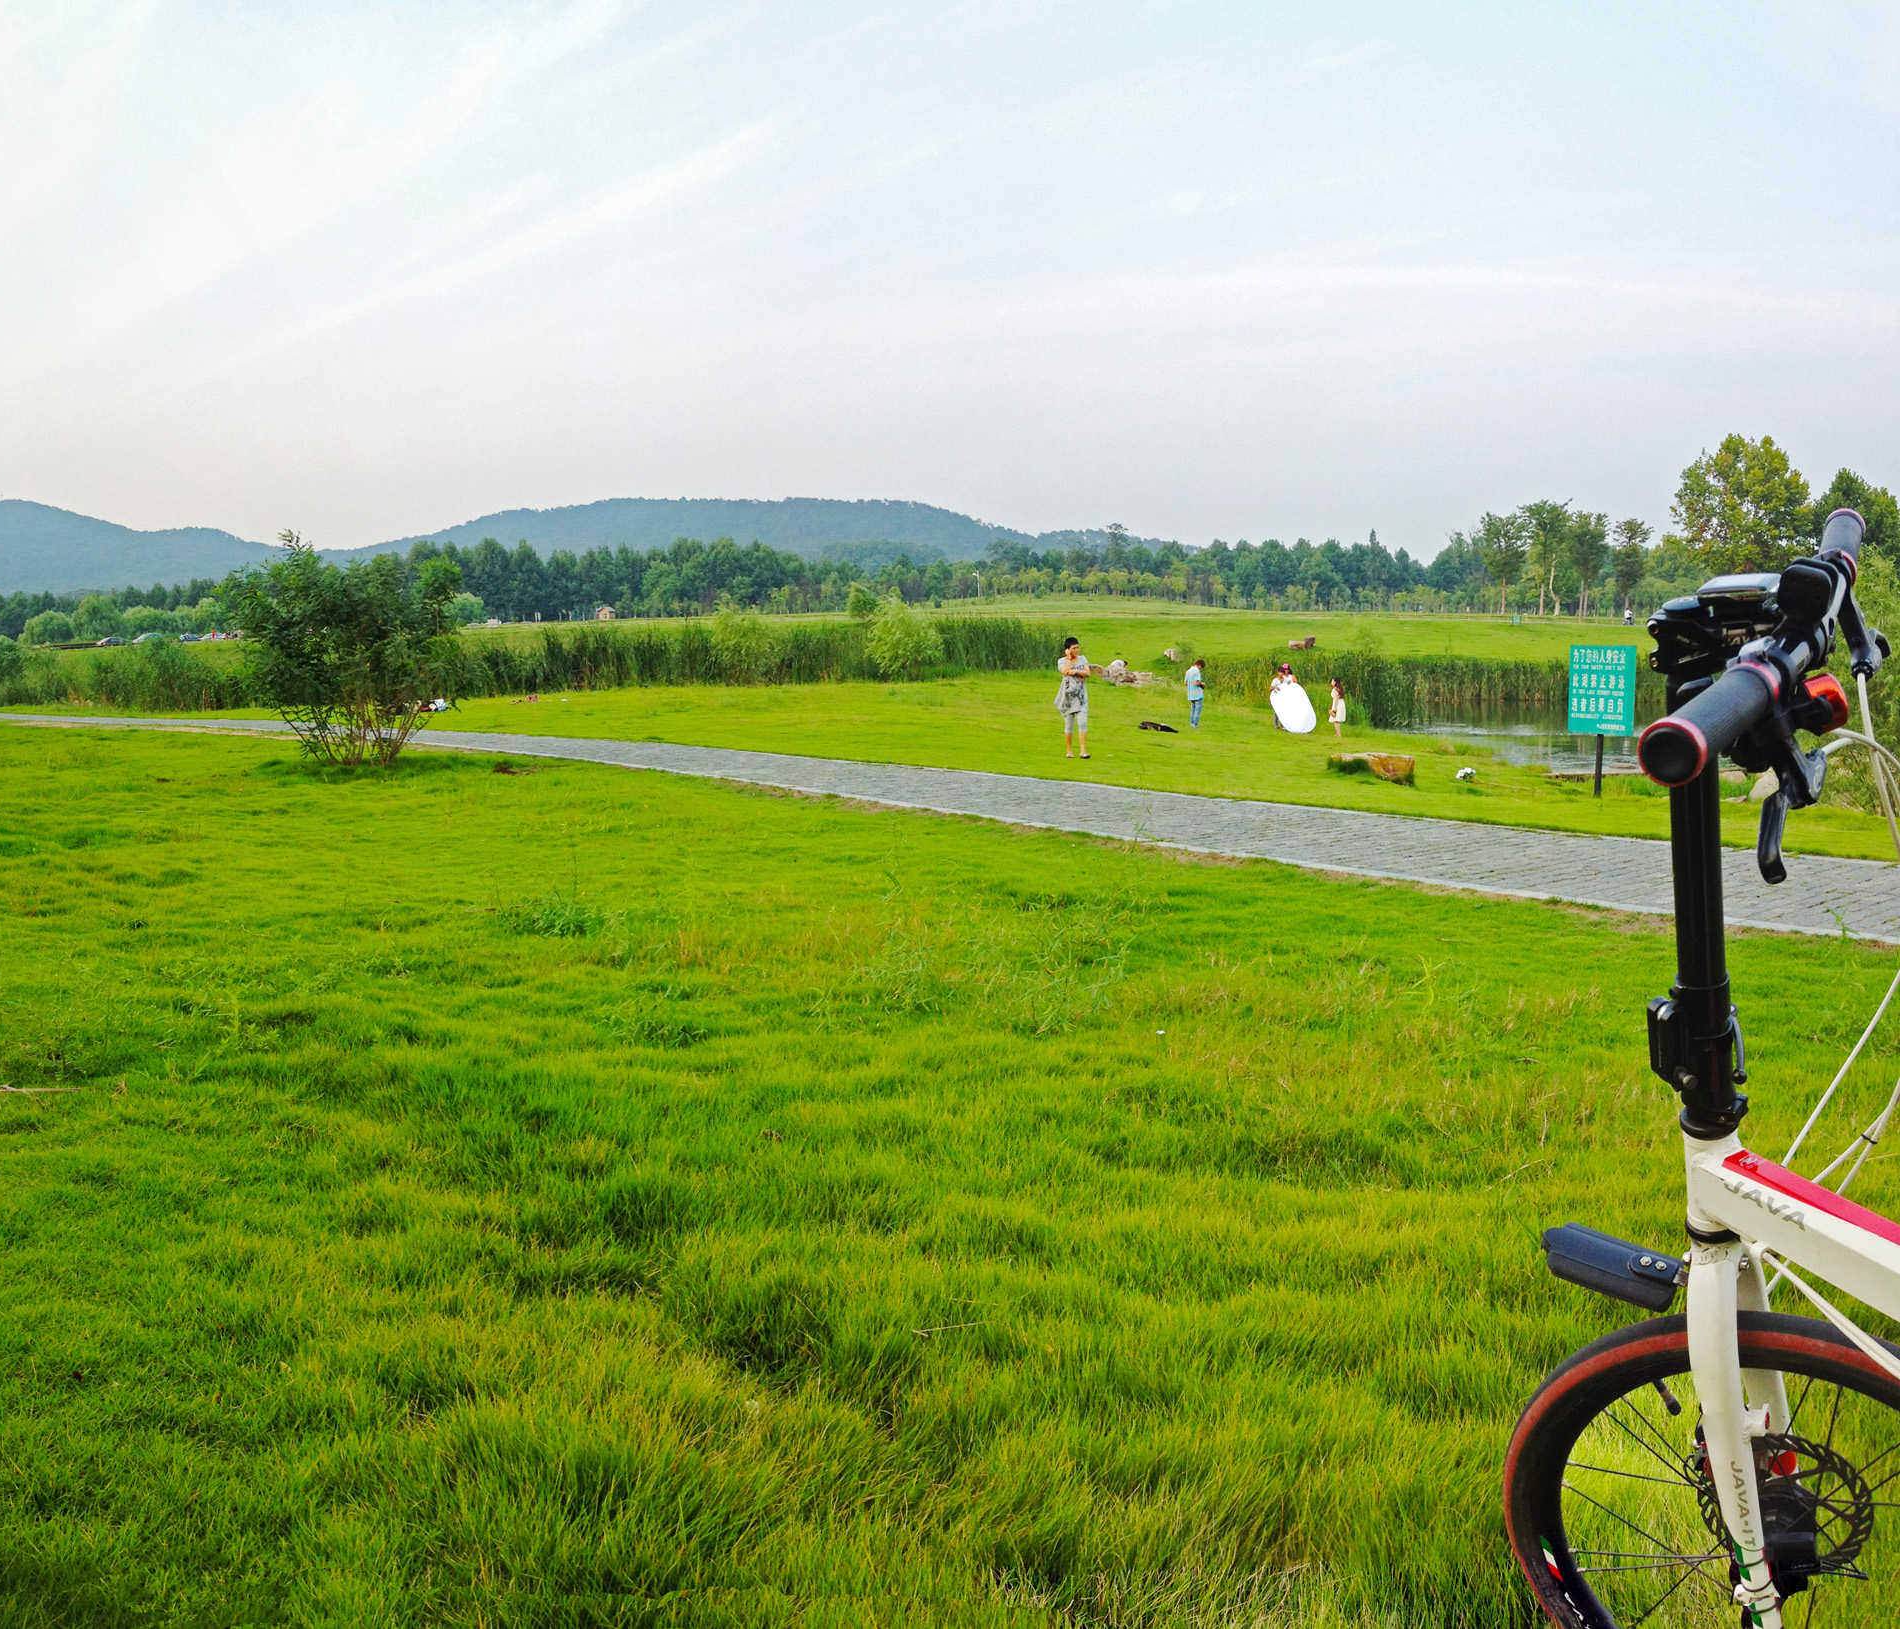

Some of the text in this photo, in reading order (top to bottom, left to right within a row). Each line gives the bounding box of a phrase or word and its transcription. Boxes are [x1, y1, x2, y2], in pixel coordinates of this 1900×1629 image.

[1573, 648, 1626, 664] 为了您的人身安全
[1572, 673, 1625, 690] 此湖禁止游泳
[1723, 1181, 1806, 1232] JAVA
